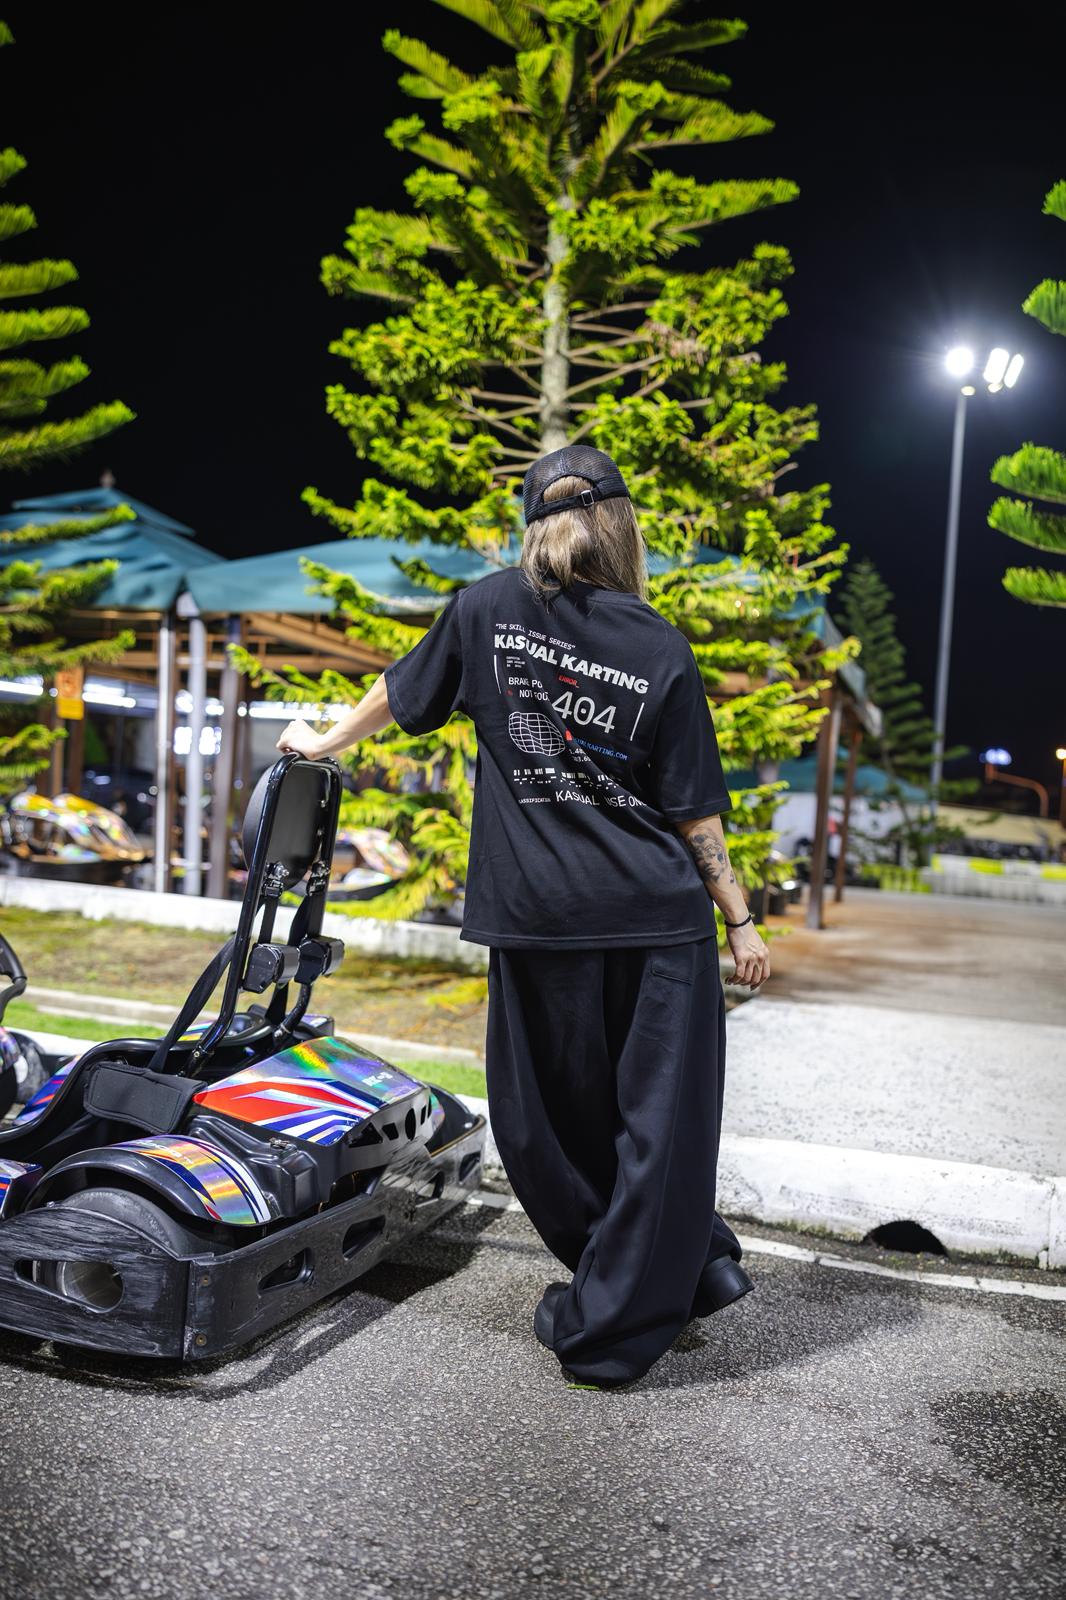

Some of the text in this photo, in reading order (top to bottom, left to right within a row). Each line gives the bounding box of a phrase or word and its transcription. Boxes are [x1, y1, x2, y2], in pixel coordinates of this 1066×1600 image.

[509, 624, 525, 633] SKILL
[528, 629, 547, 642] ISSUE
[494, 634, 650, 695] KASUAL KARTING
[551, 690, 617, 734] 404
[555, 790, 600, 806] KASUAL
